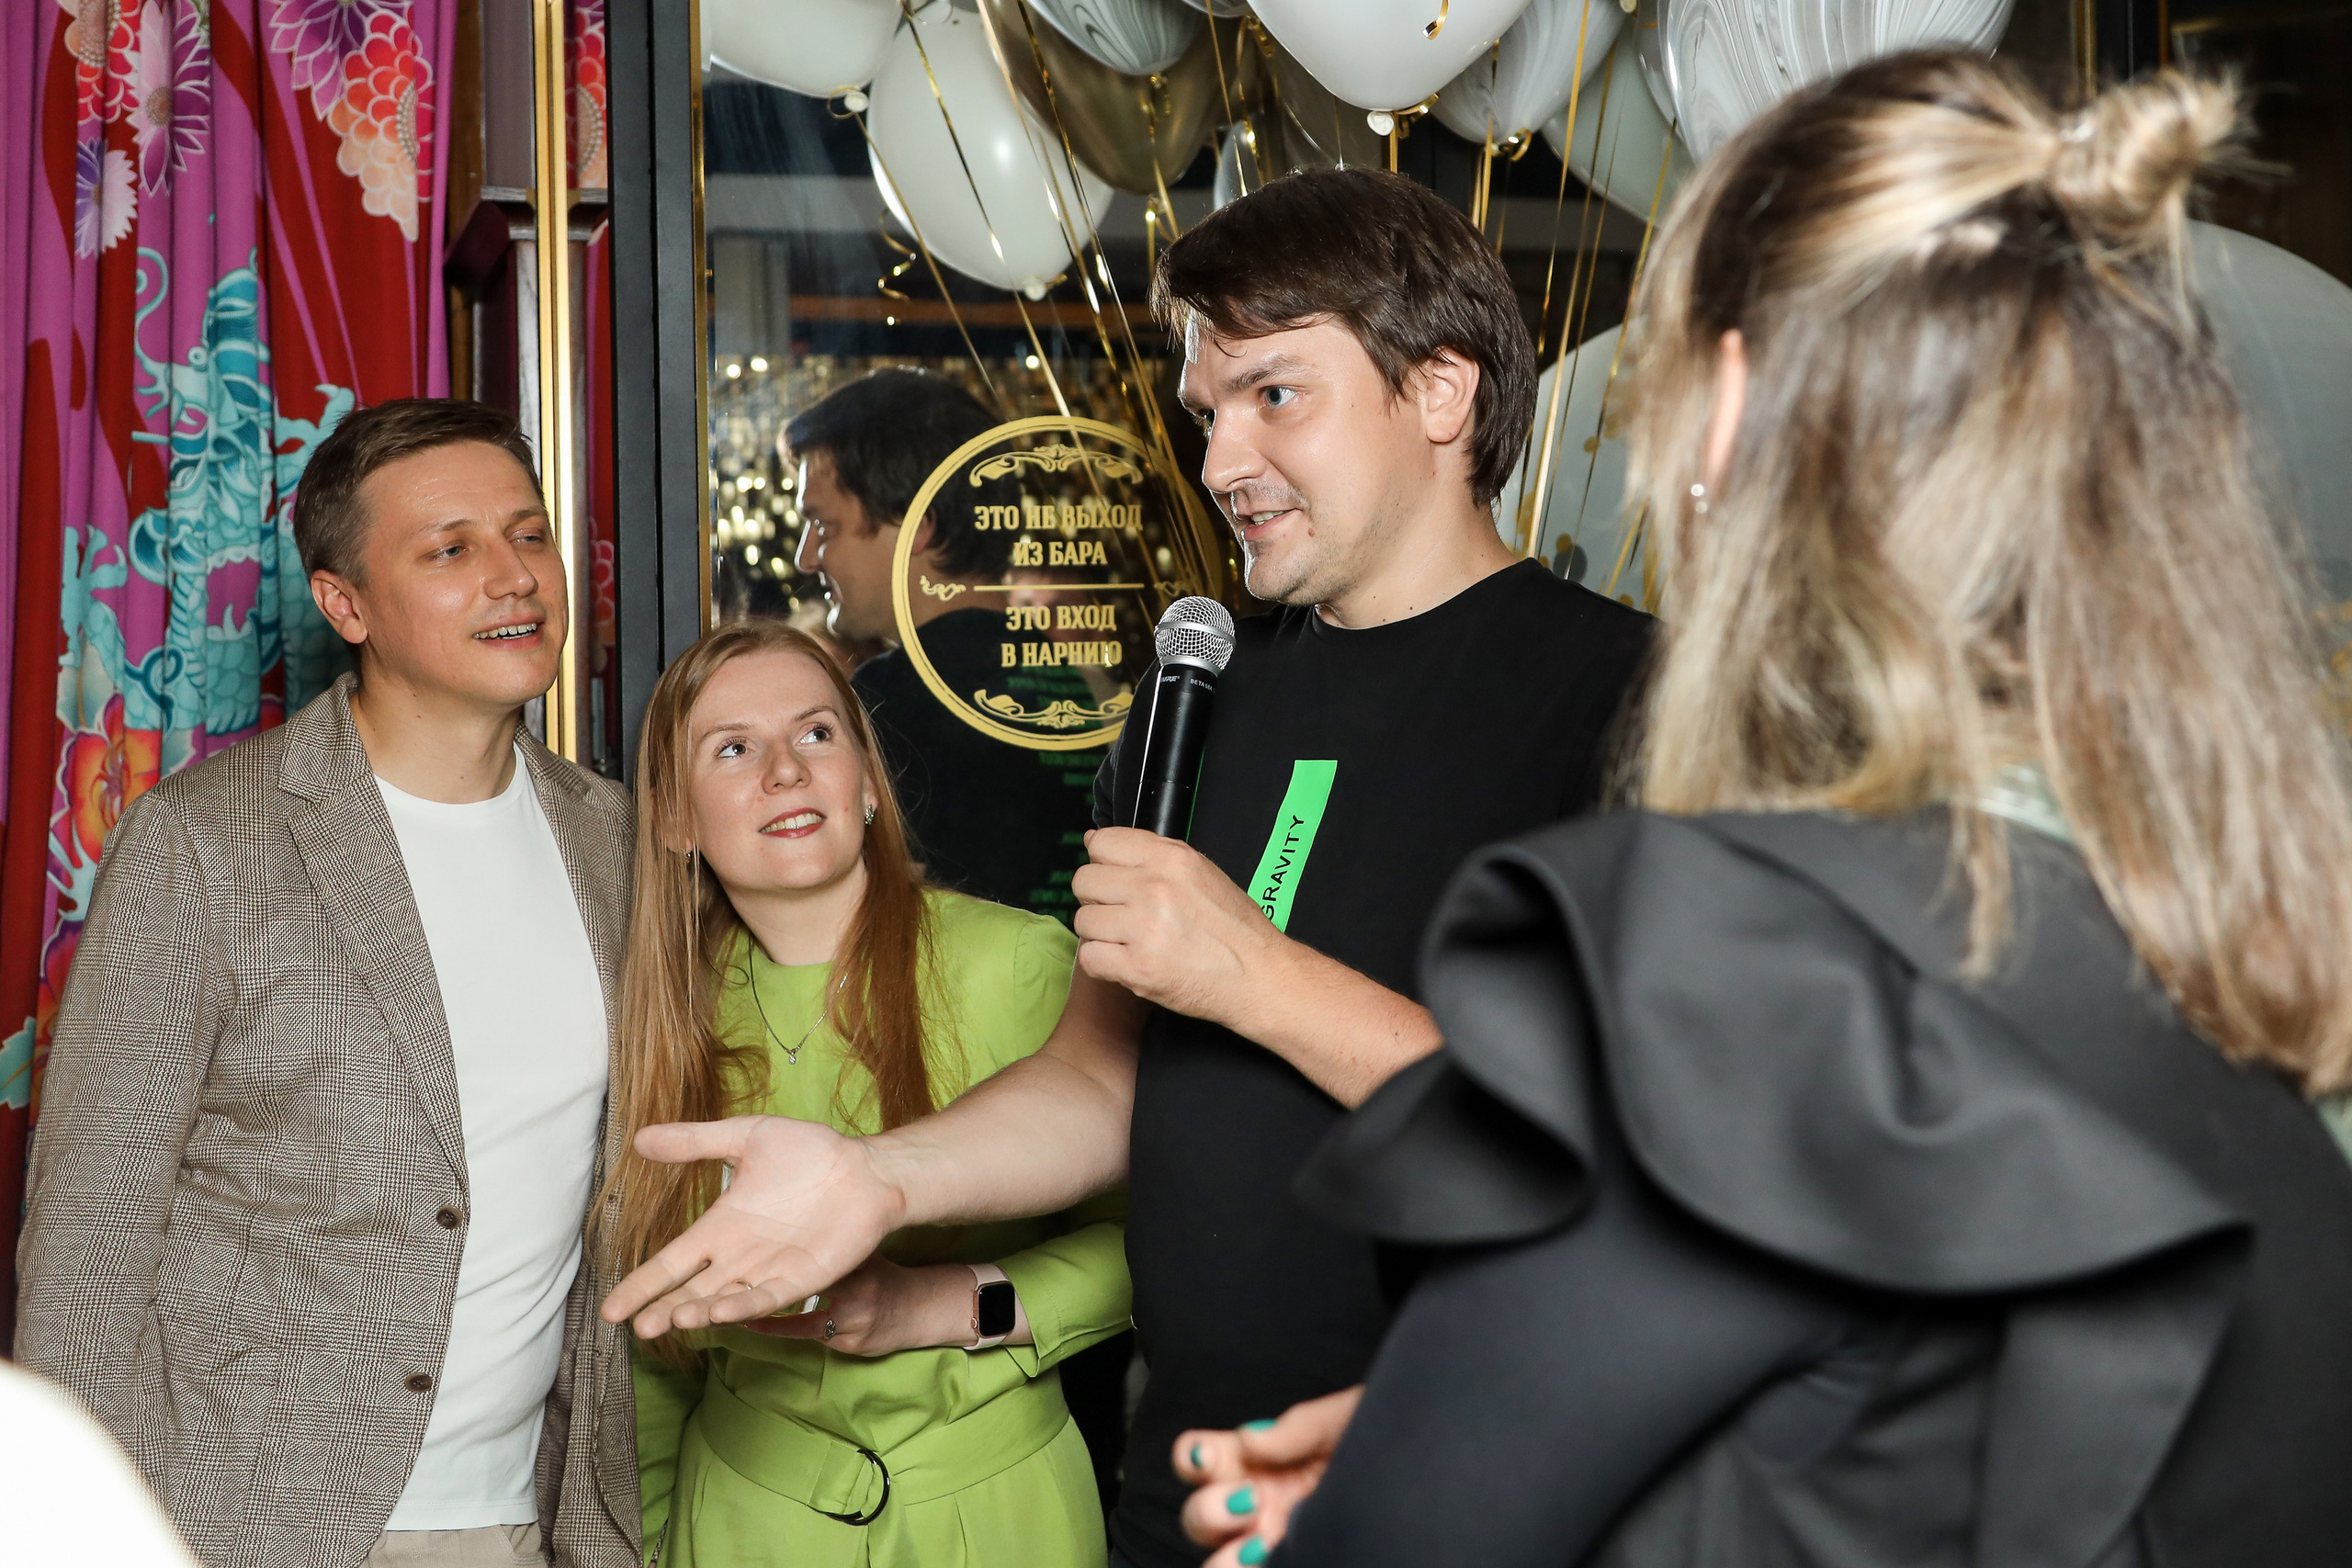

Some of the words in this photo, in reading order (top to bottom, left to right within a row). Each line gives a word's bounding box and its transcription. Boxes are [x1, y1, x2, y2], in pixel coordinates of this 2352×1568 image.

[974, 505, 1020, 531] ЭТО
[1024, 505, 1057, 530] НЕ
[1060, 504, 1143, 531] ВЫХОД
[1012, 541, 1044, 567] ИЗ
[1048, 540, 1108, 566] БАРА
[1005, 606, 1051, 631] ЭТО
[1056, 604, 1117, 632] ВХОД
[1001, 643, 1017, 668] В
[1022, 640, 1123, 668] НАРНИЮ
[1190, 678, 1205, 687] BETA
[1261, 814, 1305, 921] GRAVITY
